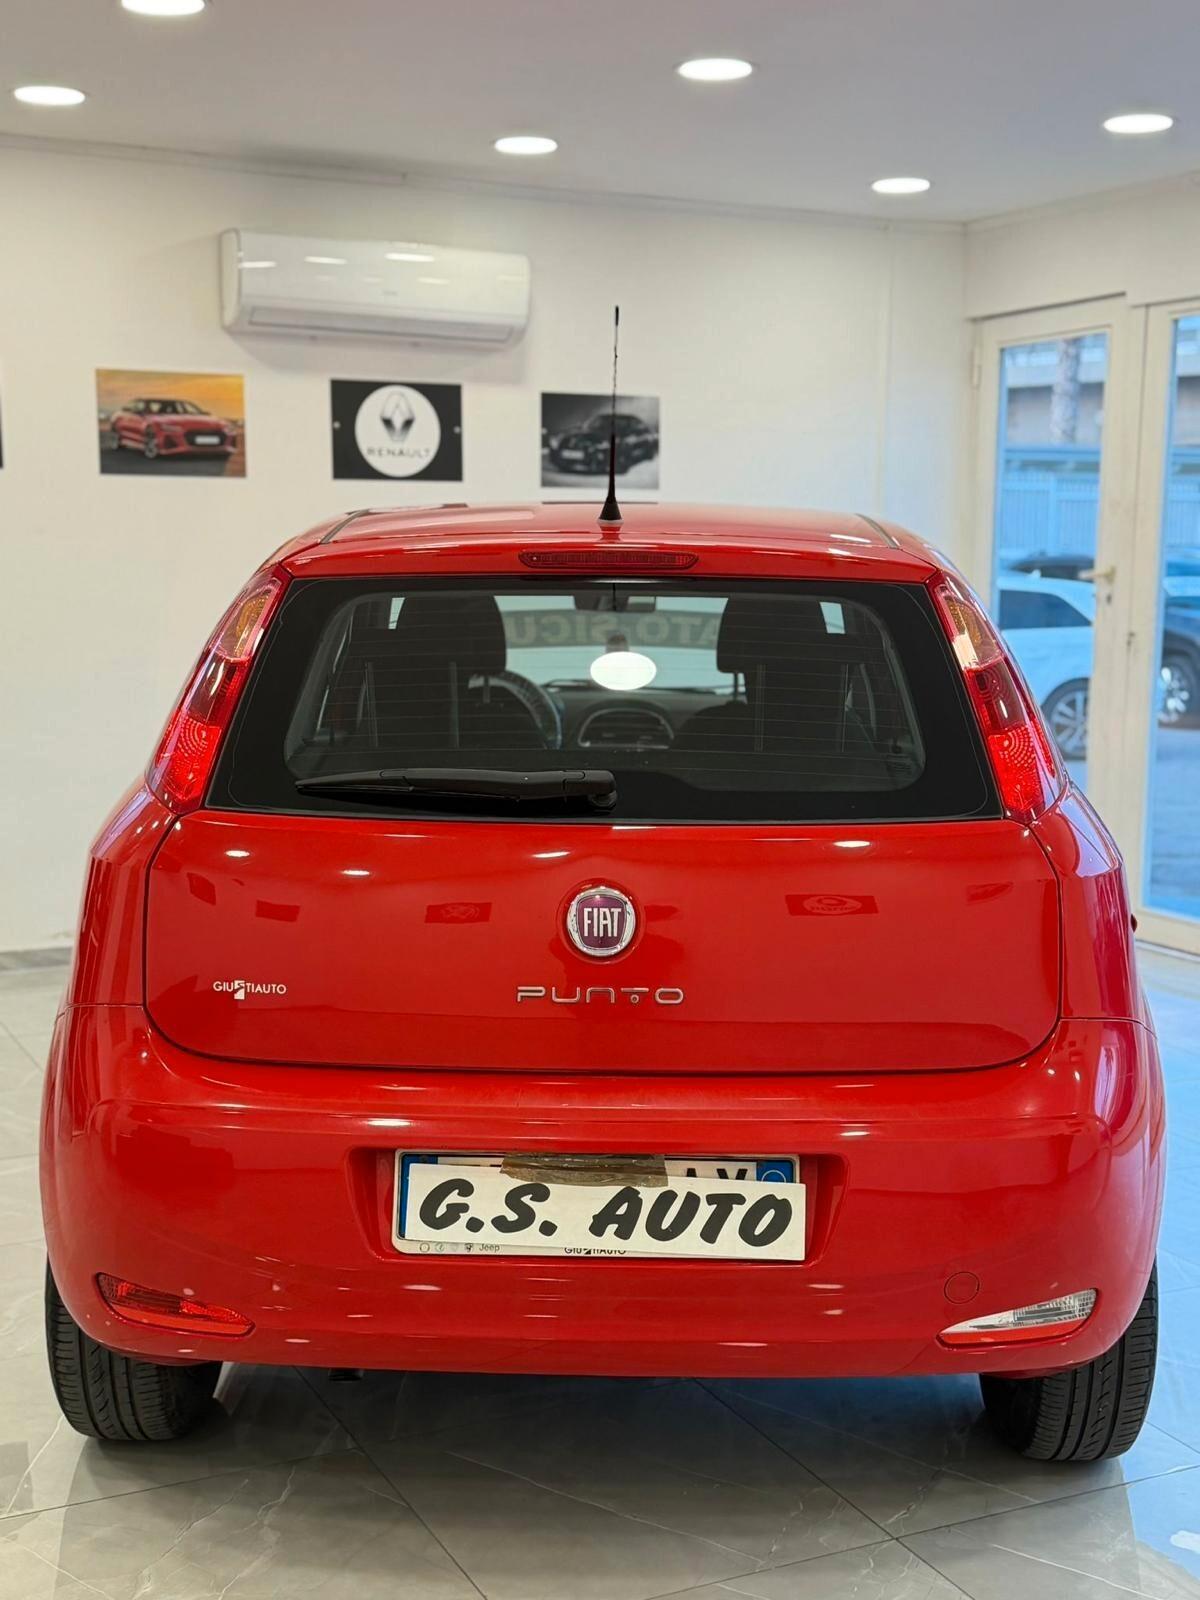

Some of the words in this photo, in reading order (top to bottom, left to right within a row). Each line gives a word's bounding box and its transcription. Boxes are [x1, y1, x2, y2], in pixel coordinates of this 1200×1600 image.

[366, 446, 430, 459] RENAULT
[583, 907, 622, 938] FIAT
[212, 980, 287, 1000] GIUSTIAUTO
[517, 986, 684, 1004] PUNTO
[418, 1177, 559, 1237] G.S.
[588, 1185, 793, 1248] AUTO
[479, 1243, 500, 1253] Jeep
